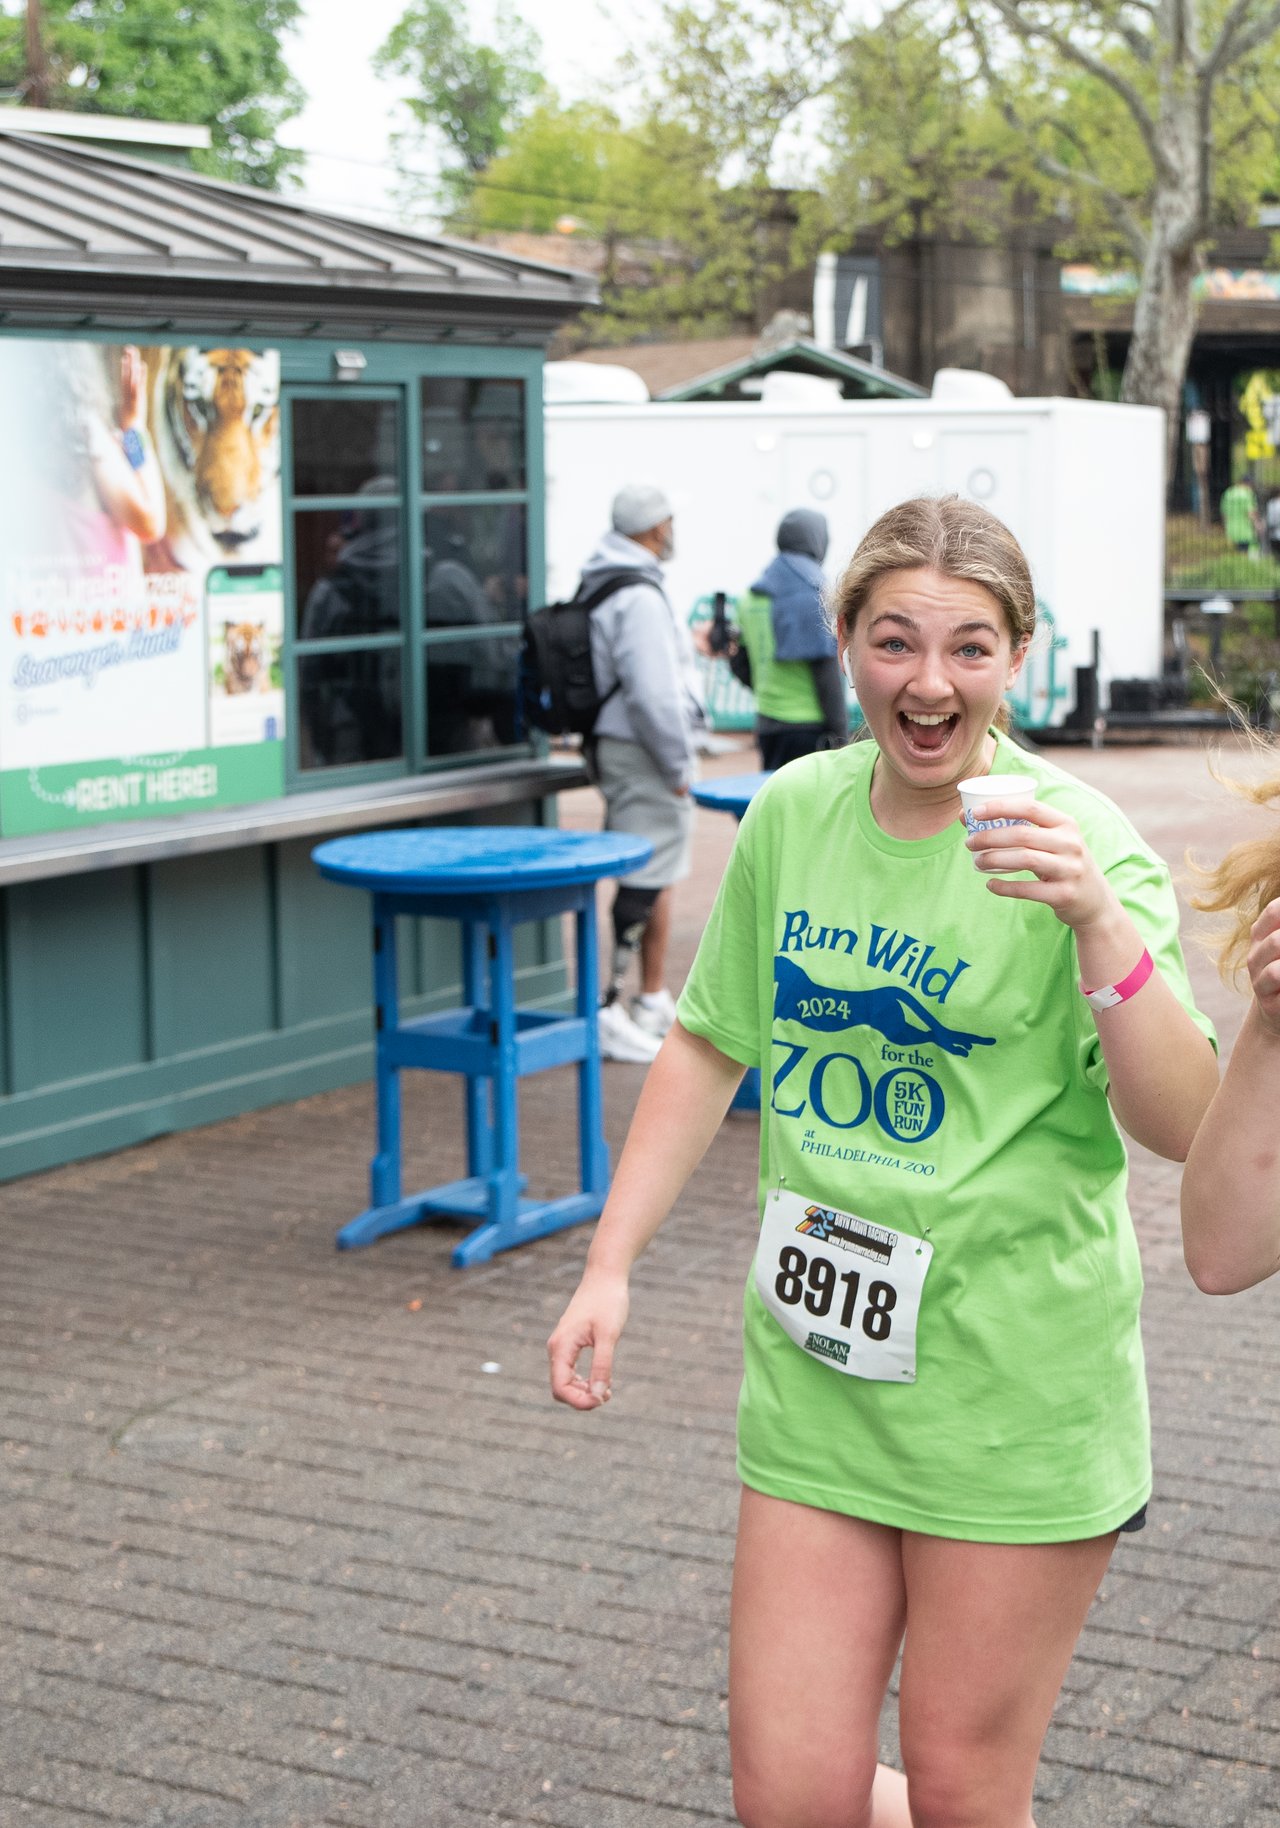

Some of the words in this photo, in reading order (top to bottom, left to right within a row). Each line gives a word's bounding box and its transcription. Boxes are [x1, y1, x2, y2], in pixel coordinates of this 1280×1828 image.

[76, 772, 144, 812] RENT
[145, 764, 218, 803] HERE!
[779, 910, 858, 954] Run
[866, 924, 971, 1004] Wild
[797, 997, 851, 1020] 2024
[881, 1044, 905, 1063] for
[907, 1051, 934, 1068] the
[770, 1039, 945, 1144] ZOO
[894, 1081, 924, 1102] 5K
[894, 1101, 925, 1117] FUN
[804, 1128, 815, 1139] at
[894, 1114, 923, 1132] RUN
[800, 1141, 900, 1169] PHILADELPHIA
[903, 1161, 935, 1176] ZOO
[775, 1245, 897, 1341] 8918
[812, 1334, 847, 1356] NOLAN
